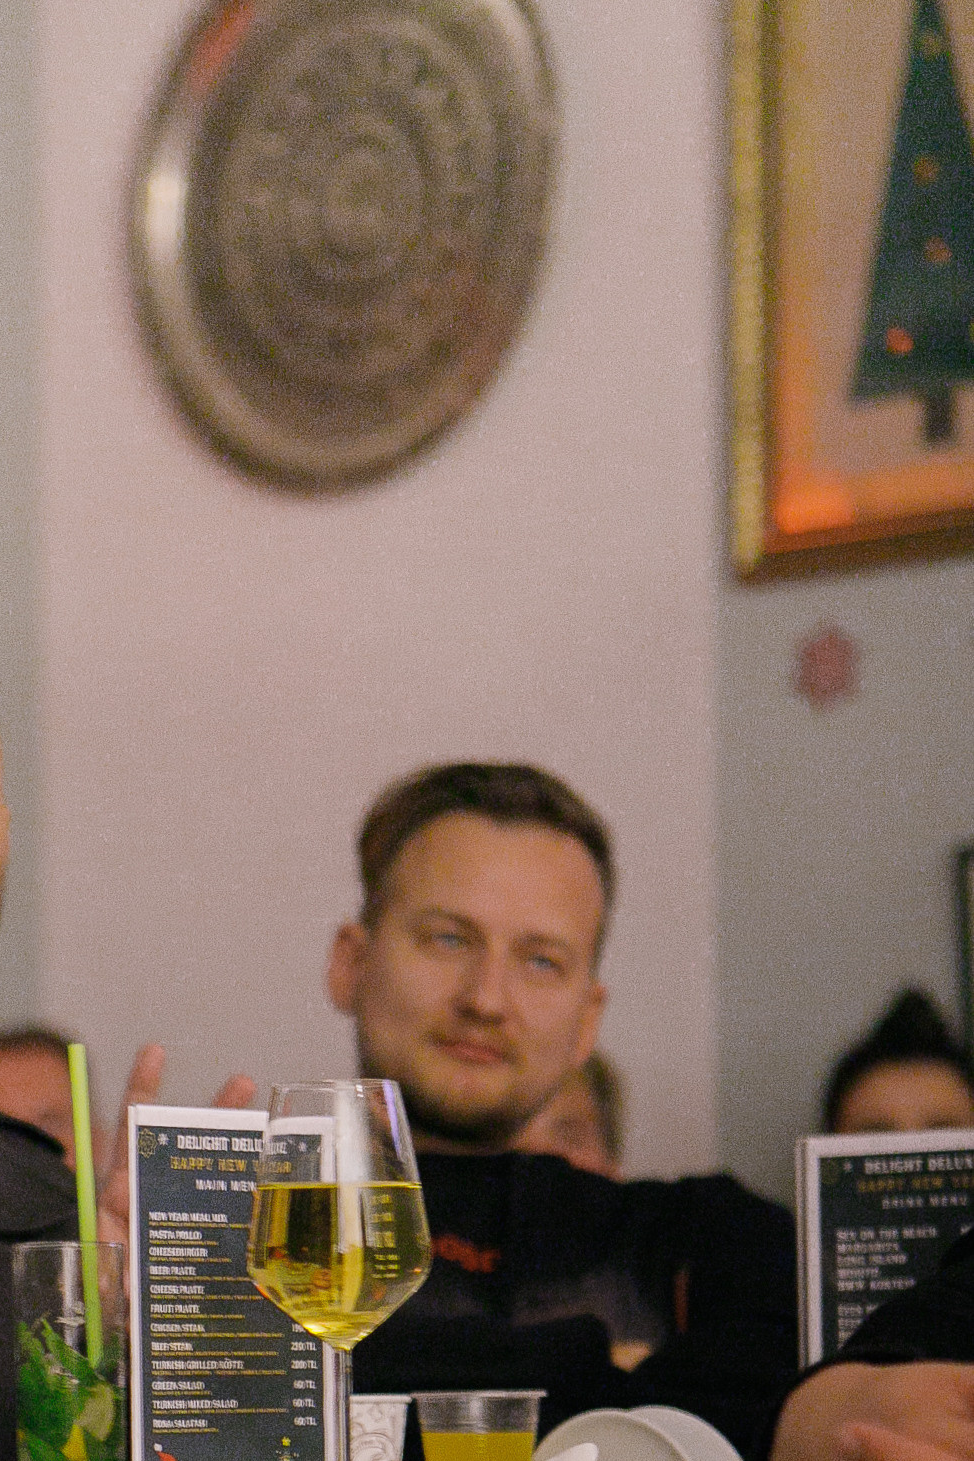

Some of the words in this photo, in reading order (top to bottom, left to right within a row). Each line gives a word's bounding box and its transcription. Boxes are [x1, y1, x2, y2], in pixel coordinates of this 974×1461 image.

[177, 1135, 229, 1152] DELIGHT
[170, 1156, 213, 1171] HAPPY
[218, 1158, 247, 1172] NEW
[864, 1158, 923, 1174] DELIGHT
[927, 1155, 974, 1171] DELUX
[195, 1179, 227, 1191] MAIN
[231, 1180, 257, 1192] MEN
[929, 1194, 968, 1207] MENU
[149, 1211, 168, 1221] NEW
[149, 1229, 175, 1240] PASTA
[178, 1381, 205, 1390] SALAD
[212, 1399, 238, 1409] SALAD
